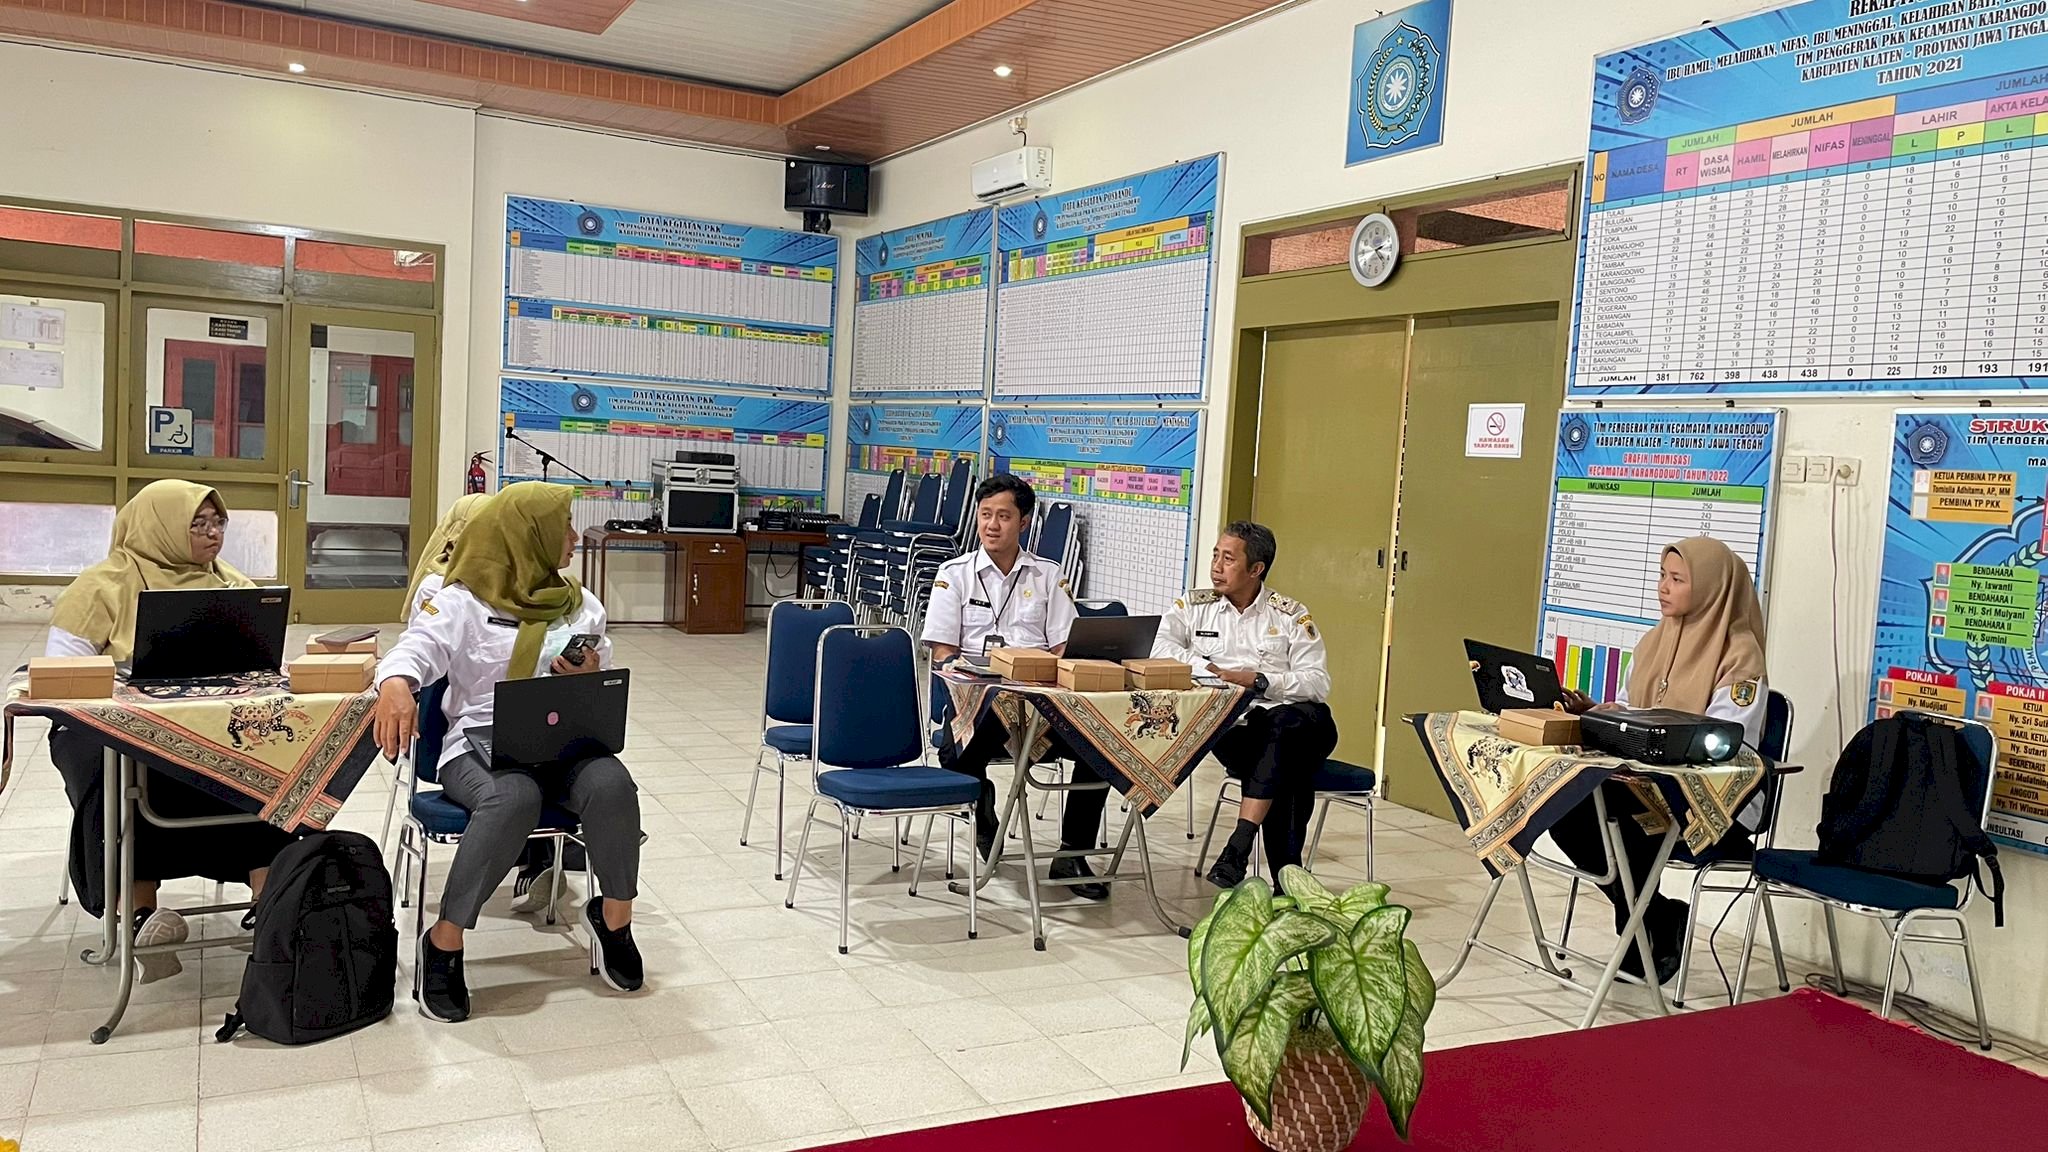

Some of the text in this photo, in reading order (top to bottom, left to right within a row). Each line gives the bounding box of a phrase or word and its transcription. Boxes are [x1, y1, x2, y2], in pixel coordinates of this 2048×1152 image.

[1667, 68, 1682, 80] IBU
[1684, 60, 1713, 76] HAMIL,
[1716, 46, 1777, 68] MELAHIRKAN,
[1781, 37, 1809, 52] NIFAS,
[1814, 31, 1832, 45] IBU
[1833, 17, 1896, 40] MENINGGAL,
[1901, 1, 1964, 25] KELAHIRAN
[1796, 52, 1812, 65] TIM
[1816, 36, 1878, 61] PENGGERAK
[1882, 31, 1905, 46] PKK
[1910, 16, 1974, 41] KECAMATAN
[1801, 58, 1859, 81] KABUPATEN
[1863, 49, 1902, 68] KLATEN
[1915, 36, 1968, 57] PROVINSI
[1972, 28, 2002, 47] JAWA
[2007, 21, 2048, 39] TENGA
[1878, 57, 1962, 84] TAHUN 2021
[1990, 102, 2018, 113] AKTA
[1791, 112, 1834, 127] JUMLAH
[1922, 111, 1957, 125] LAHIR
[2006, 124, 2013, 133] L
[1682, 134, 1719, 148] JUMLAH
[1852, 133, 1890, 146] MENINGGAL
[1957, 132, 1965, 140] P
[1814, 140, 1845, 153] NIFAS
[1911, 139, 1918, 147] L
[1773, 147, 1808, 159] MELAHIRKAN
[1704, 155, 1729, 165] DASA
[1737, 155, 1767, 165] HAMIL
[1676, 167, 1687, 176] RT
[1700, 166, 1731, 178] WISMA
[1594, 174, 1605, 182] NO
[640, 216, 659, 225] DATA
[663, 218, 701, 230] KEGIATAN
[704, 224, 720, 233] PKK
[1690, 372, 1705, 380] 762
[1724, 371, 1740, 380] 398
[1761, 370, 1778, 379] 438
[1800, 369, 1818, 378] 438
[1847, 368, 1853, 377] 0
[1886, 367, 1901, 376] 225
[1932, 365, 1947, 375] 219
[1977, 364, 1998, 373] 193
[2028, 363, 2048, 373] 191
[633, 391, 714, 404] DATA KEGIATAN PKK
[155, 411, 174, 432] P
[1594, 423, 1769, 435] TIM PENGGERAK PKK KECAMATAN KARANGDOWO
[1596, 437, 1634, 447] KABUPATEN
[1636, 437, 1661, 447] KLATEN
[1671, 437, 1706, 448] PROVINSI
[1708, 438, 1730, 448] JAWA
[1733, 439, 1763, 449] TENGAH
[1967, 436, 1987, 444] TIM
[1623, 454, 1690, 465] GRAFIK IMUNISASI
[1589, 466, 1728, 481] KECAMATAN KARANGDOWO TAHUN 2022
[1934, 472, 2012, 482] KETUA PEMBINA TP PKK
[1588, 483, 1620, 491] IMUNISASI
[1692, 488, 1721, 497] JUMLAH
[1999, 487, 2010, 495] MM
[1940, 498, 2000, 508] PEMBINA TP PKK
[1973, 566, 2013, 577] BENDAHARA
[1971, 580, 1982, 589] Ny.
[1969, 593, 2013, 604] BENDAHARA I
[1954, 605, 1966, 614] Ny.
[1981, 608, 1992, 616] Sri
[1965, 618, 2011, 631] BENDAHARA II
[1967, 632, 2007, 644] Ny. Sumini
[1906, 671, 1938, 684] POKJA I
[1920, 686, 1937, 696] KETUA
[2006, 685, 2045, 700] POKJA II
[1908, 698, 1917, 707] Ny.
[2023, 703, 2043, 713] KETUA
[2009, 714, 2020, 725] Ny.
[2022, 716, 2032, 726] Sri
[2010, 729, 2048, 743] WAKIL KETU
[2011, 743, 2047, 758] Ny. Sutarti
[2008, 758, 2045, 772] SEKRETARIS
[2004, 771, 2014, 780] Sri
[2010, 787, 2039, 800] ANGGOTA
[2009, 800, 2018, 810] Tri
